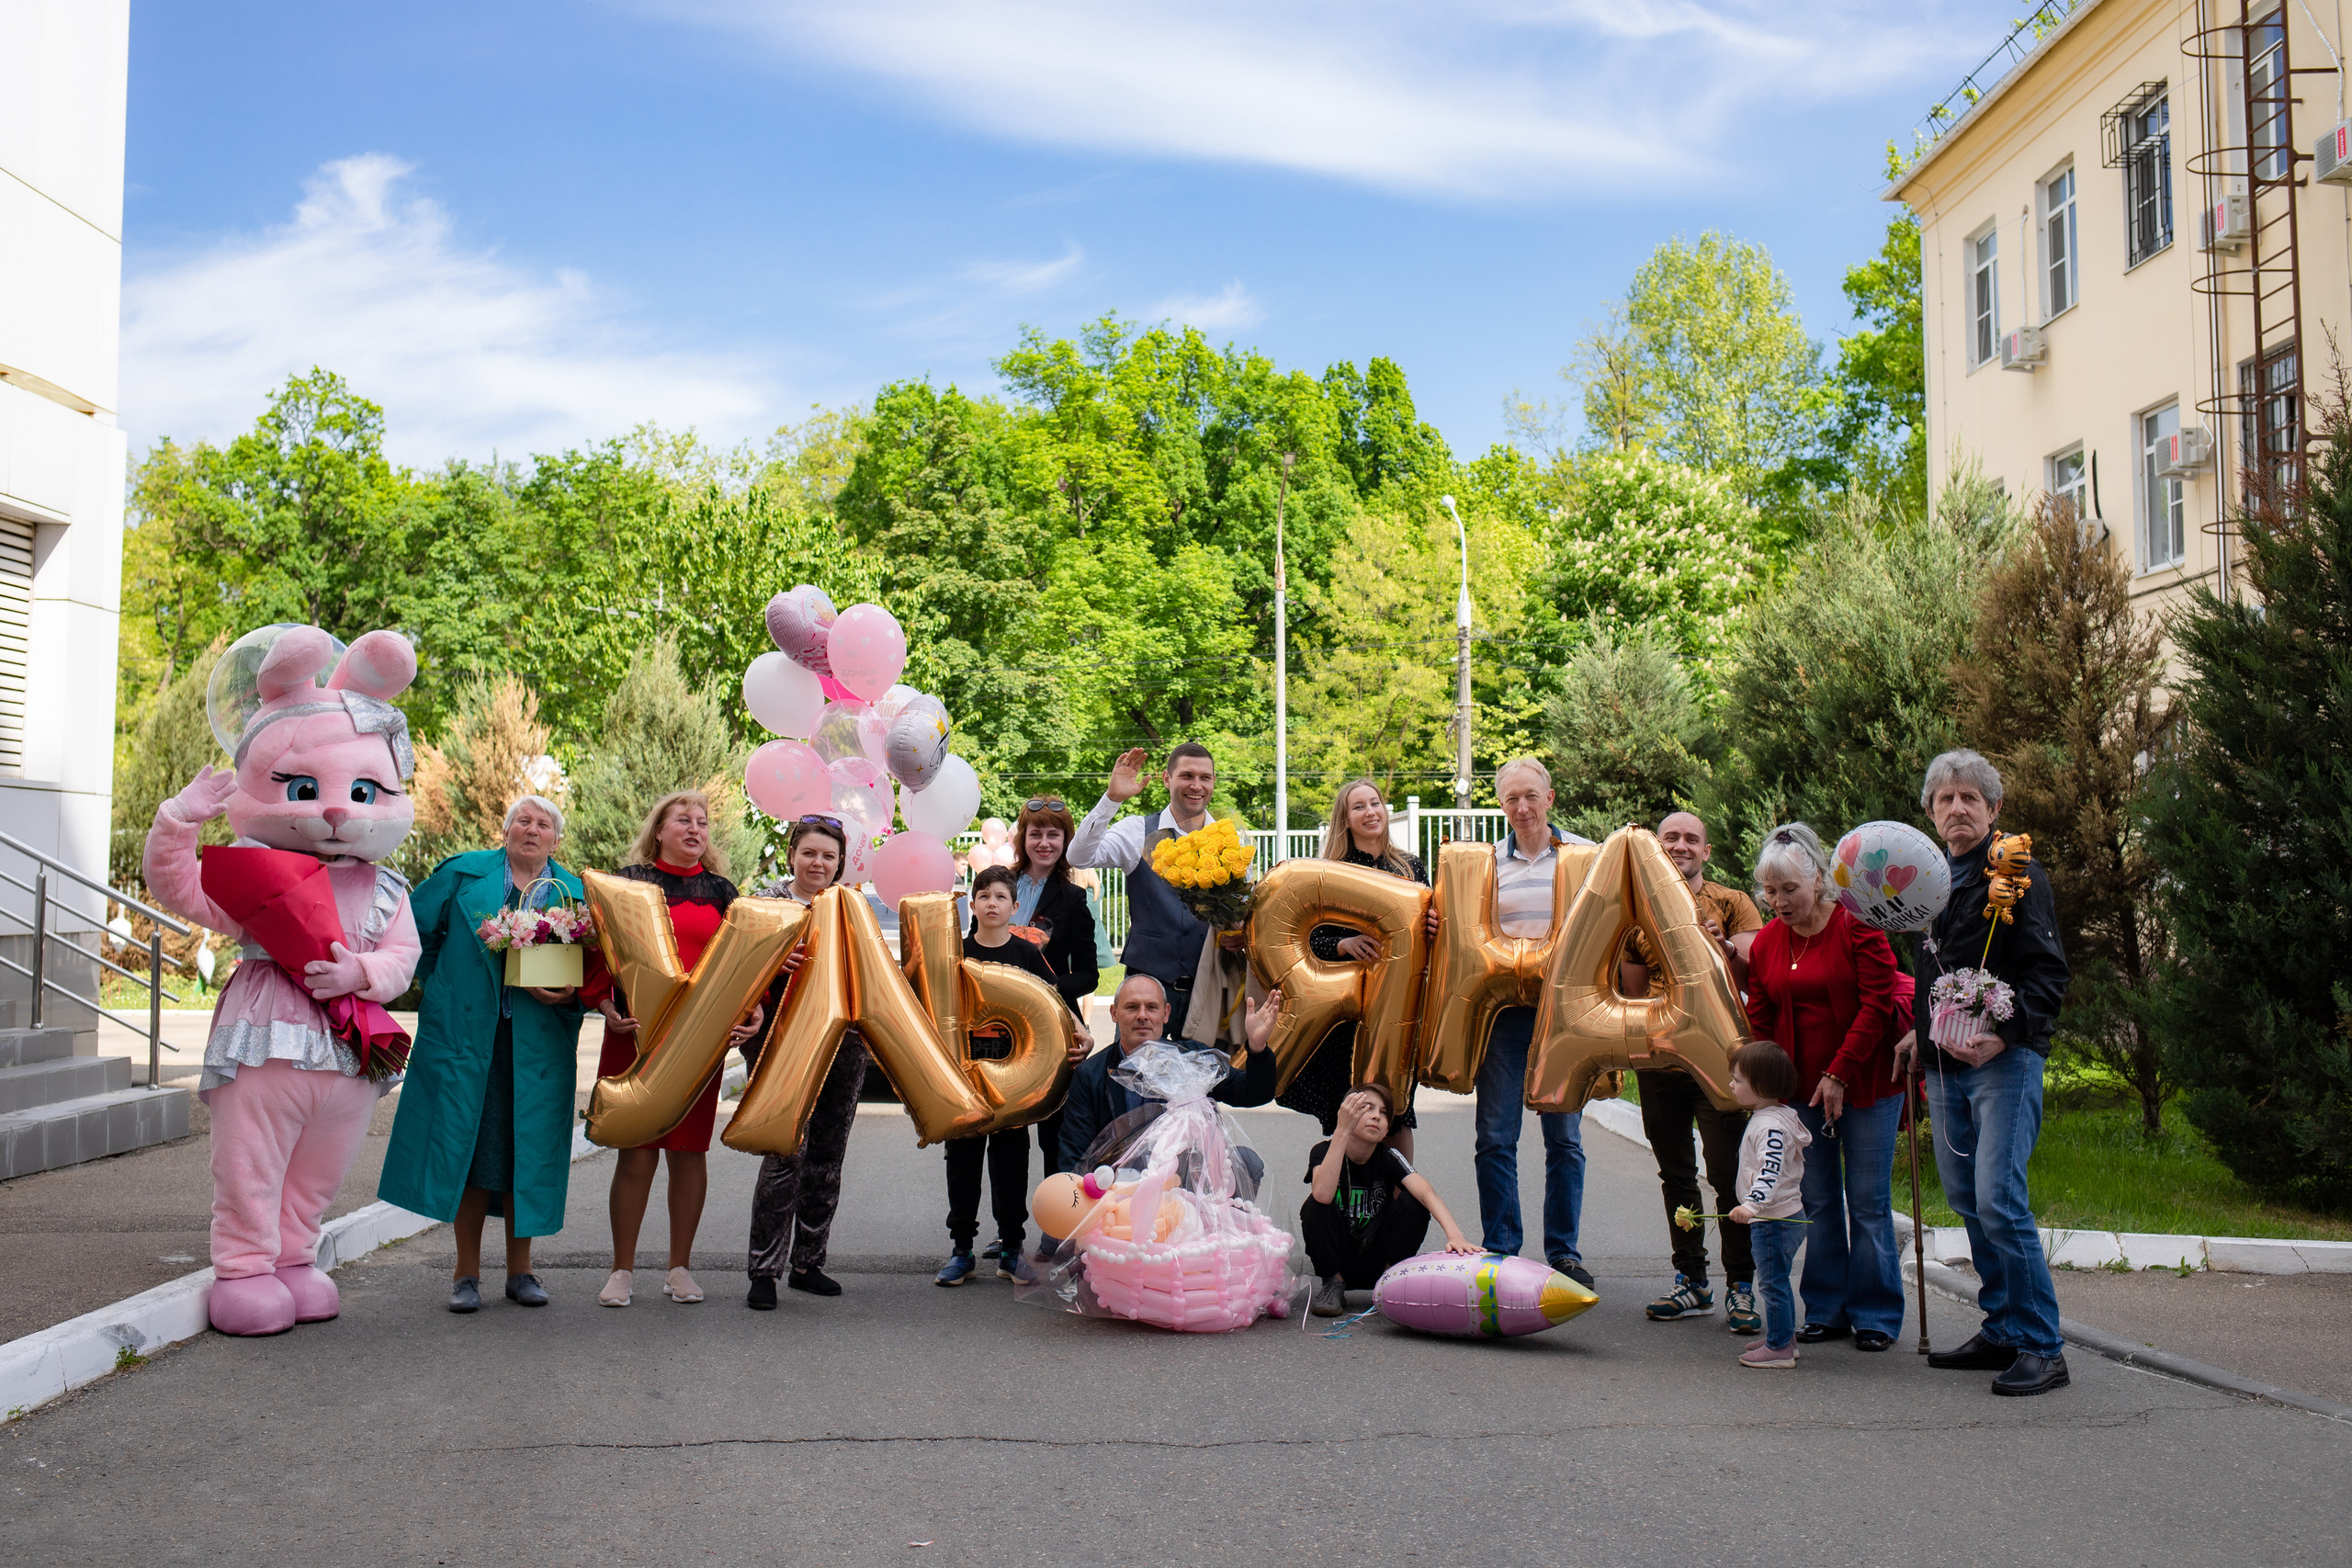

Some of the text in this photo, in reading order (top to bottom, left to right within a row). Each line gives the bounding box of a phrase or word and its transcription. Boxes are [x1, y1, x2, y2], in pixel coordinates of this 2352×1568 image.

[842, 668, 876, 678] ДОЧКИ
[852, 831, 866, 866] ДОЧКИ
[1864, 895, 1907, 922] УРА!
[1757, 1128, 1784, 1190] LOVELY
